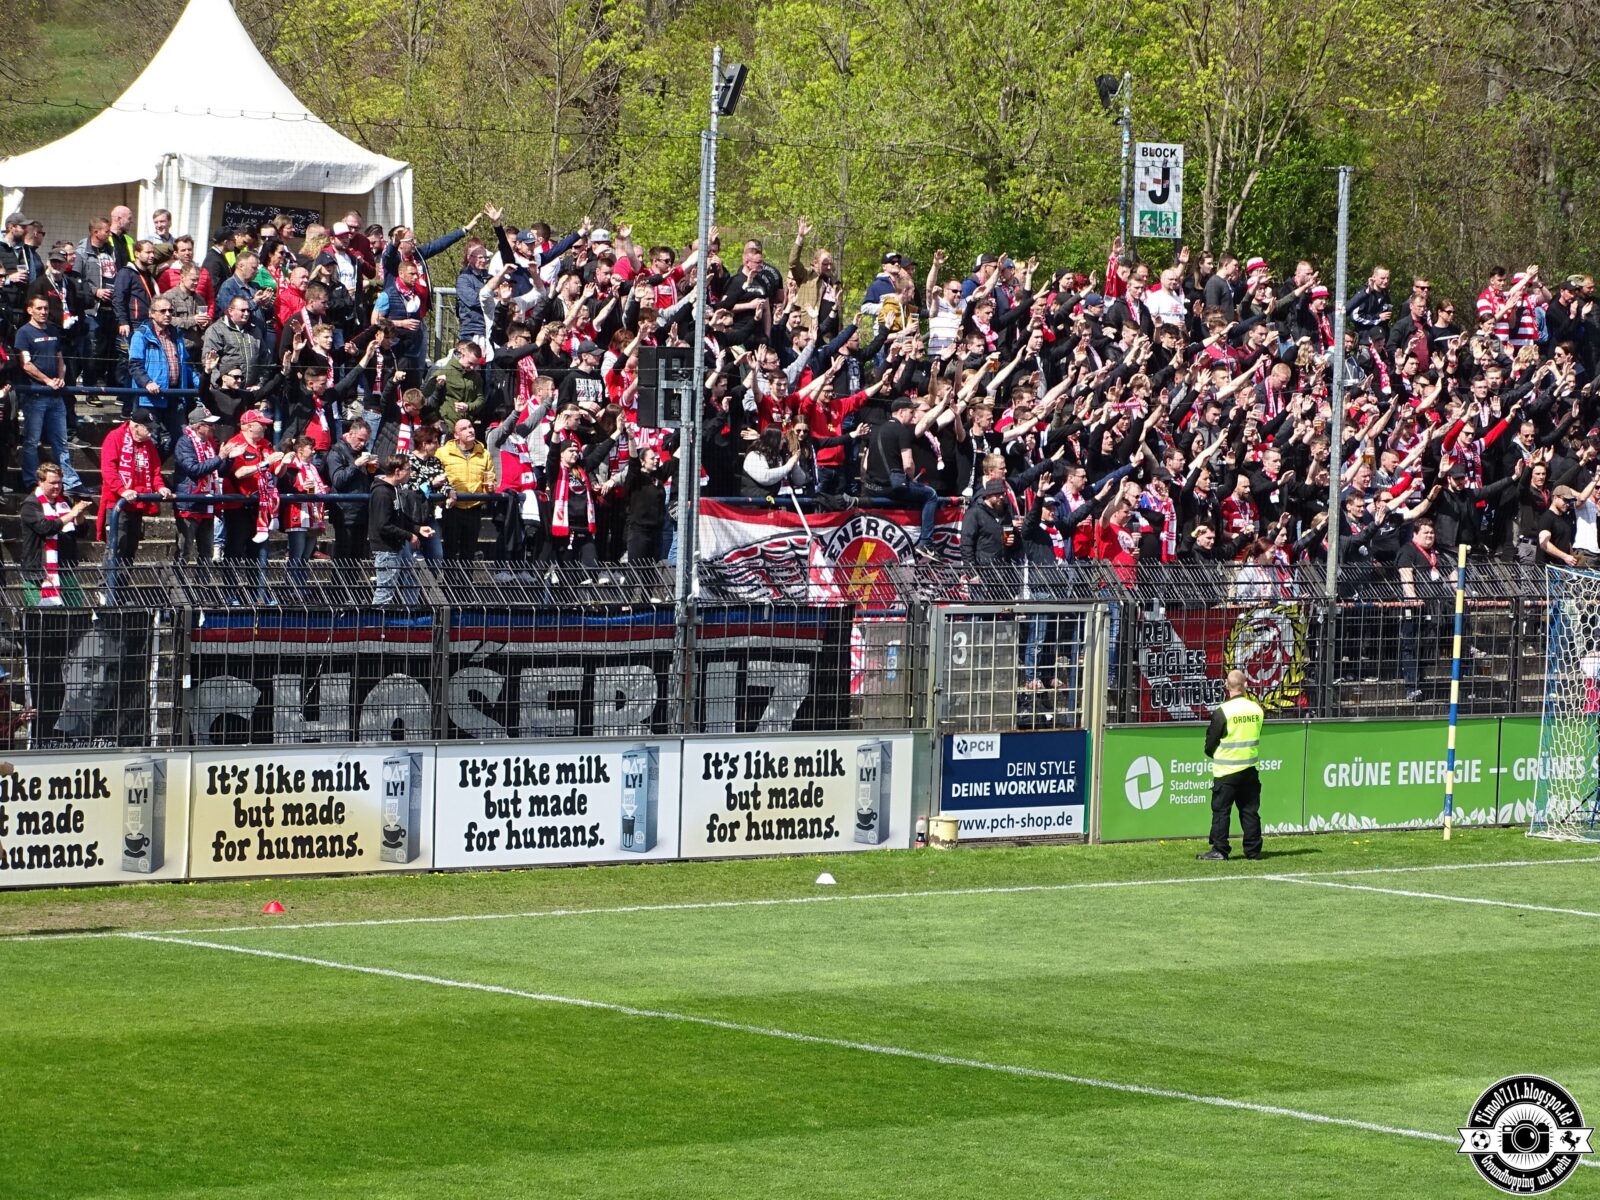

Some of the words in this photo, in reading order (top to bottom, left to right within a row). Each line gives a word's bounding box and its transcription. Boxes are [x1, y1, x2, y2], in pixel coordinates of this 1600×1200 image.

[1142, 147, 1177, 158] BLOCK
[1148, 167, 1170, 205] J
[828, 517, 912, 562] ENERGIE
[952, 631, 968, 665] 3
[1141, 620, 1173, 648] RED
[1146, 649, 1208, 679] EAGLES
[1149, 678, 1226, 709] COTTBUS
[1233, 714, 1260, 724] ORDNER
[969, 741, 994, 752] PCH
[206, 764, 249, 795] It's
[254, 763, 305, 795] like
[311, 761, 370, 791] milk
[459, 759, 498, 788] It's
[503, 757, 550, 787] like
[555, 755, 610, 785] milk
[702, 752, 739, 780] It's
[744, 750, 788, 780] like
[794, 748, 845, 777] milk
[860, 767, 877, 782] LY!
[1006, 762, 1036, 777] DEIN
[1039, 760, 1076, 775] STYLE
[1259, 759, 1283, 770] sser
[1323, 757, 1391, 788] GRÜNE
[1397, 759, 1481, 785] ENERGIE
[1513, 751, 1585, 781] GRÜNES
[48, 768, 111, 800] milk
[128, 788, 148, 804] LY!
[386, 781, 405, 796] LY!
[625, 773, 643, 789] LY!
[725, 782, 761, 811] but
[767, 781, 824, 809] made
[951, 782, 990, 797] DEINE
[994, 779, 1075, 796] WORKWEAR
[1170, 779, 1214, 790] Stadtwerk
[233, 797, 275, 828] but
[281, 795, 345, 826] made
[484, 789, 522, 819] but
[528, 788, 587, 817] made
[1169, 794, 1206, 804] Potsdam
[16, 803, 84, 835] made
[706, 813, 740, 843] for
[745, 811, 840, 842] humans.
[212, 830, 251, 862] for
[256, 828, 364, 861] humans.
[464, 822, 500, 852] for
[505, 819, 605, 850] humans.
